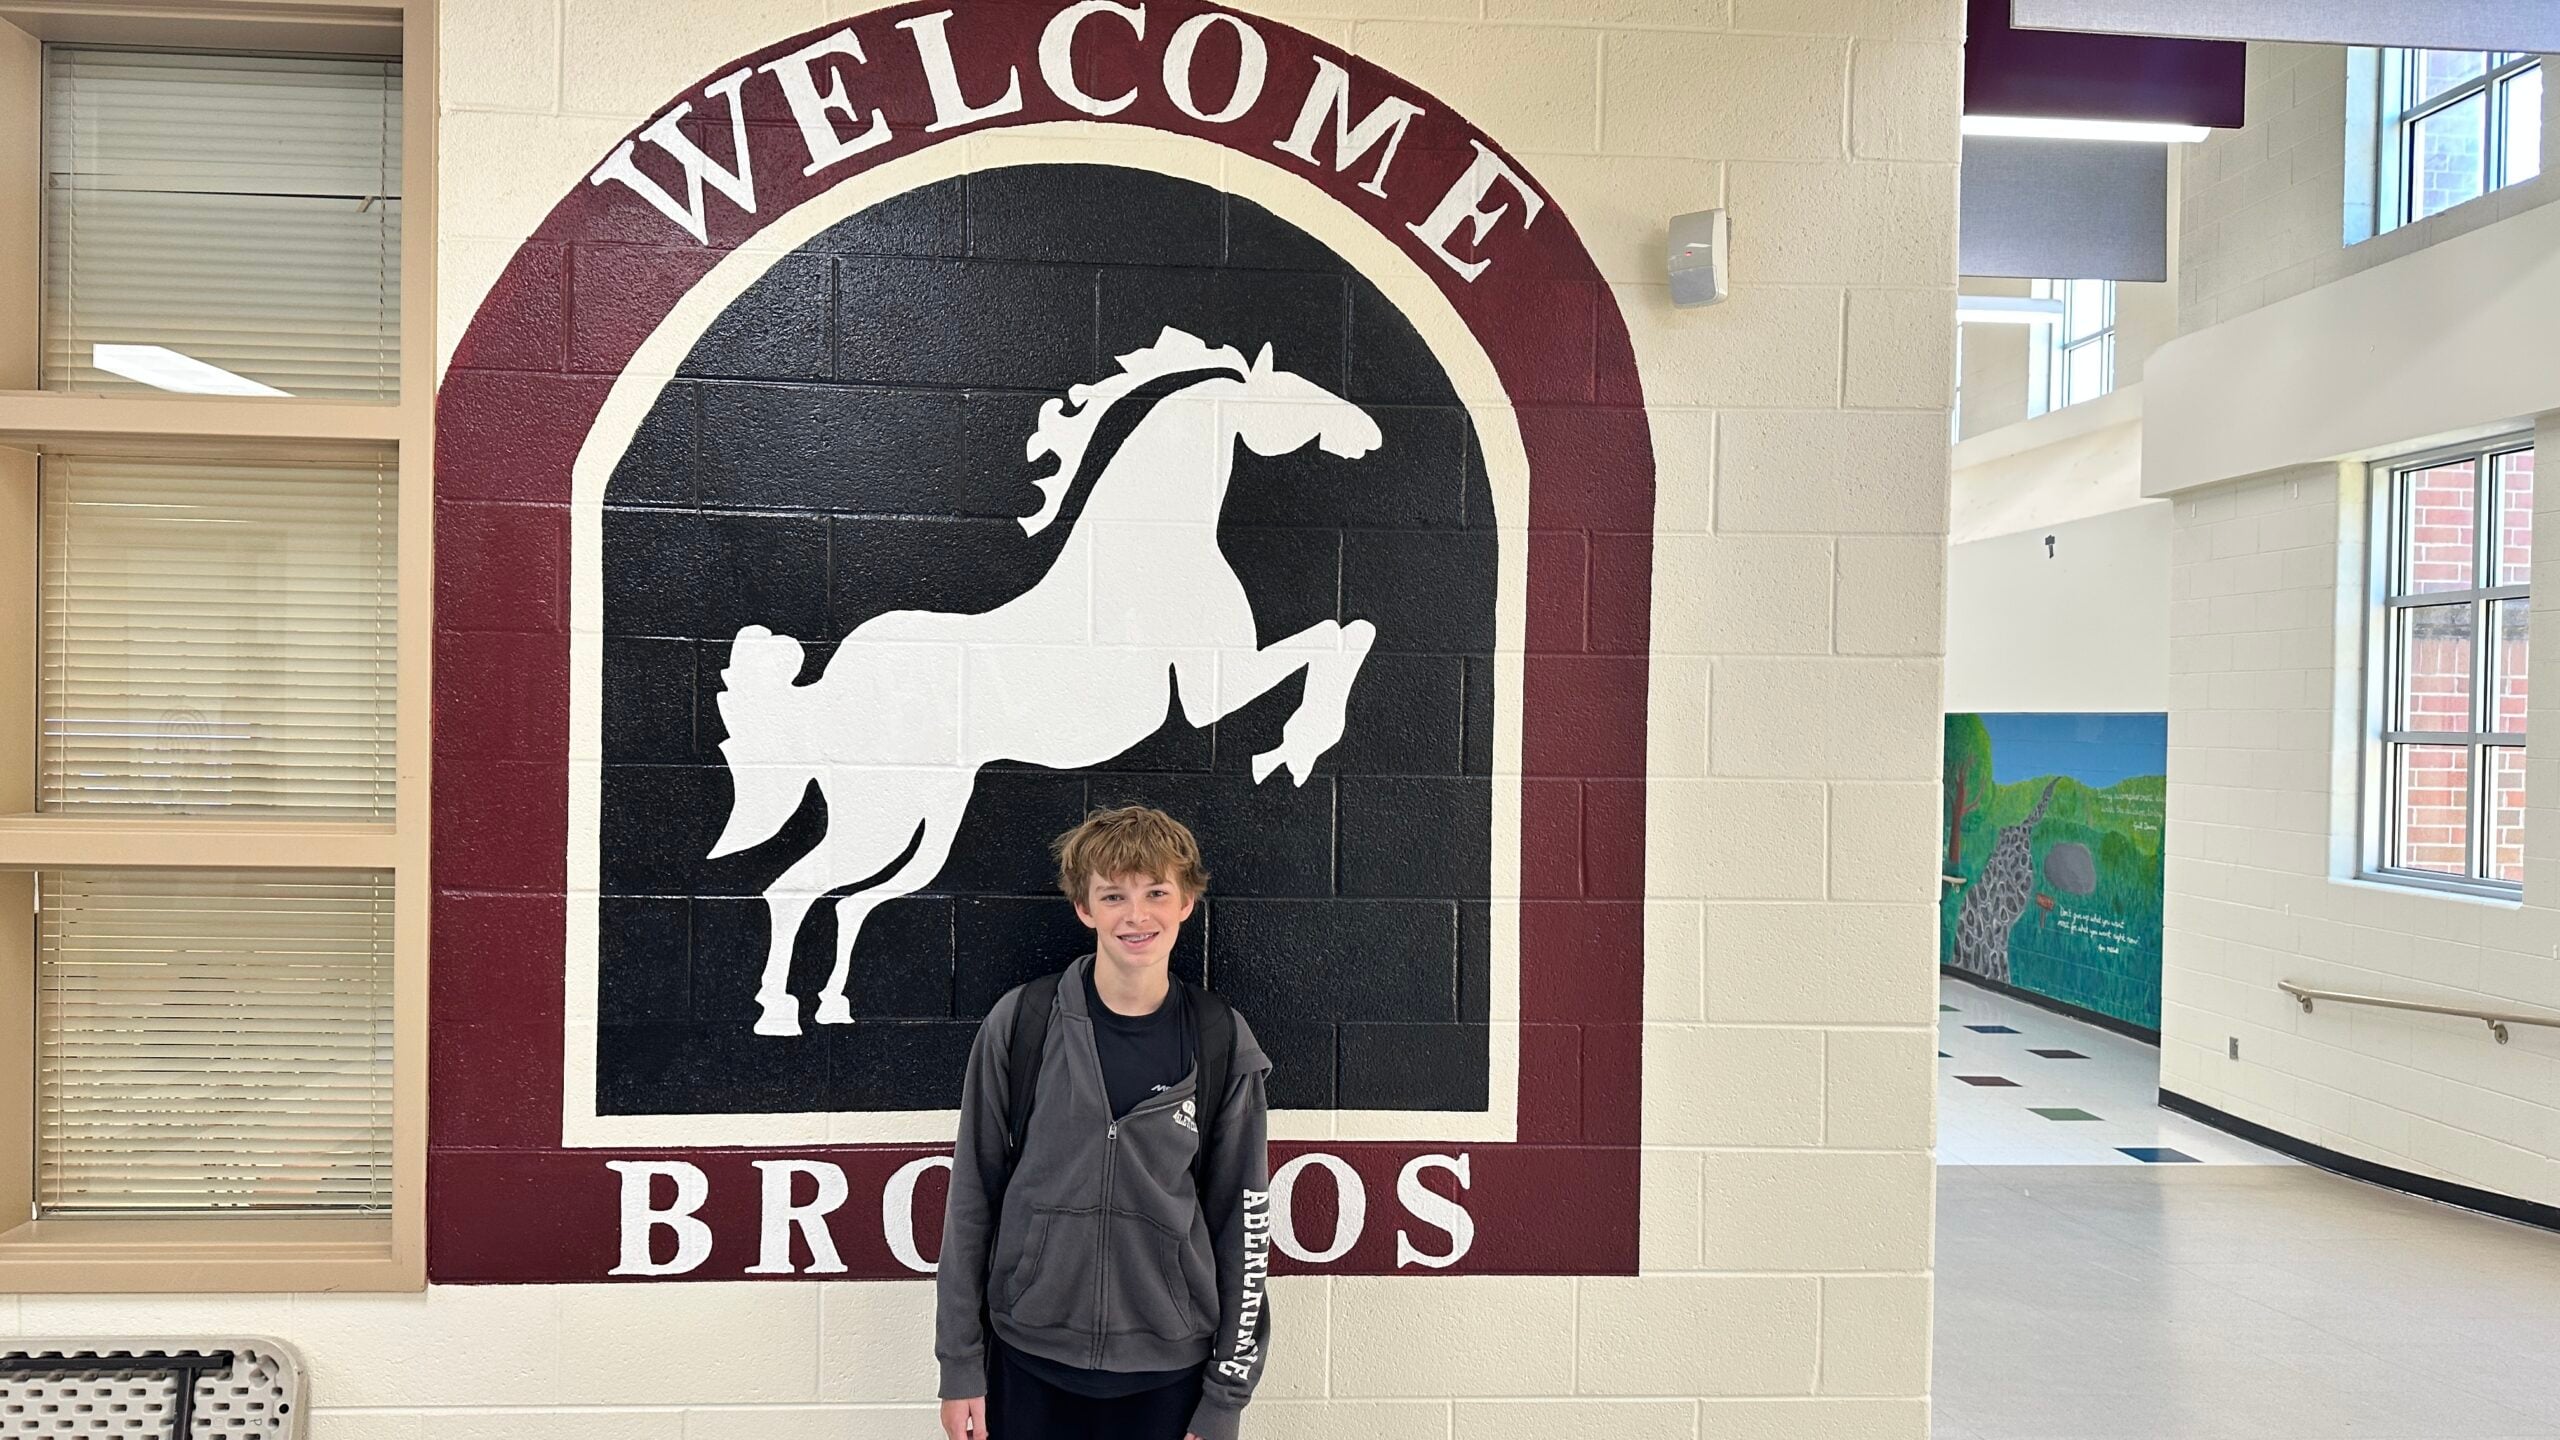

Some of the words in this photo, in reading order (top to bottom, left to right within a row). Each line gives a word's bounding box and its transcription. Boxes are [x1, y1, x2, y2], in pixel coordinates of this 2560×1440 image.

[589, 0, 1545, 283] WELCOME
[604, 1152, 1476, 1276] BROOS
[1218, 1188, 1270, 1381] ABERCROME
